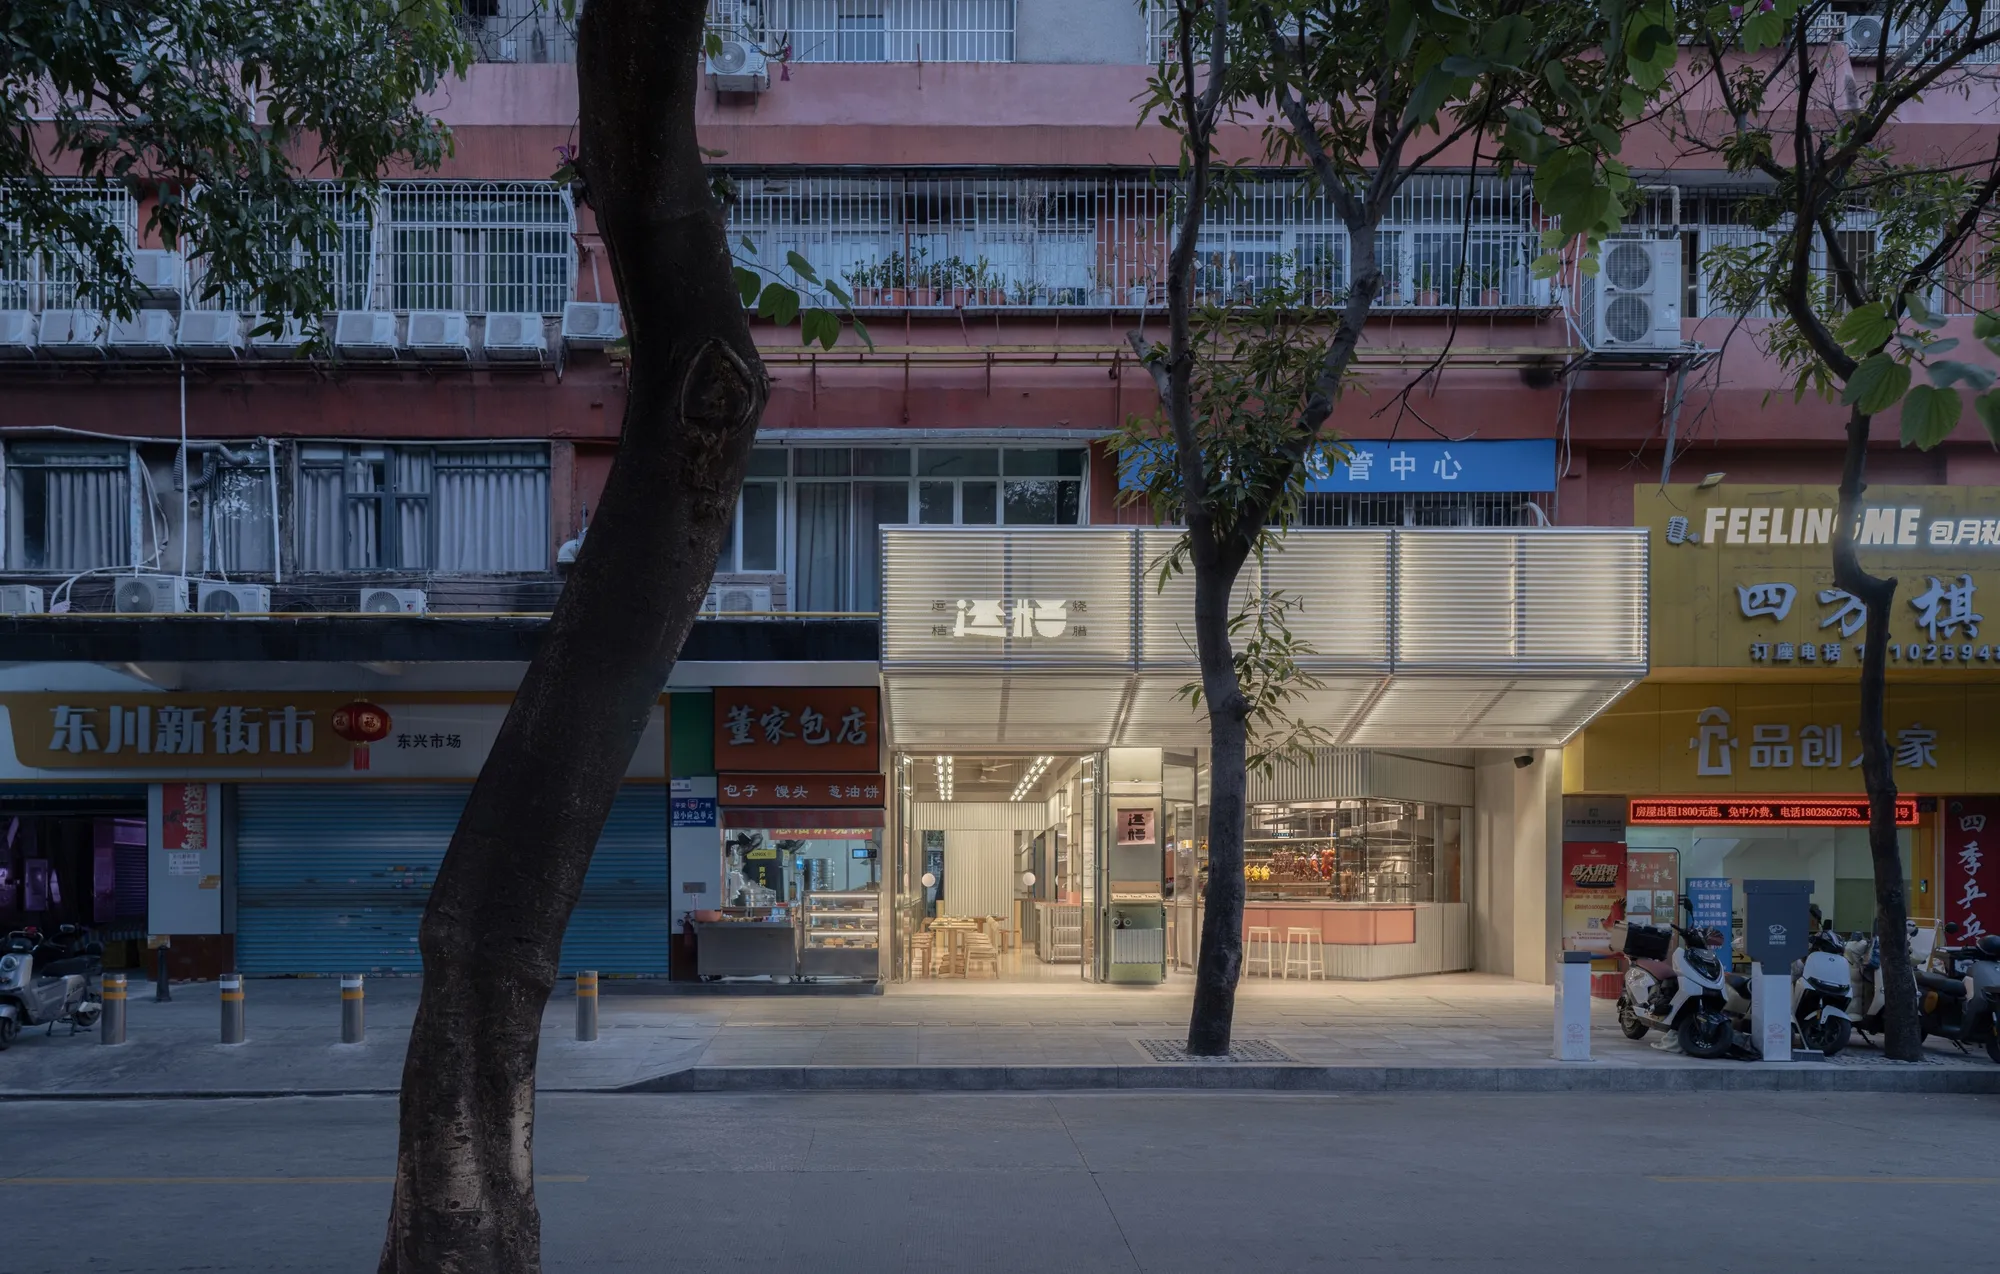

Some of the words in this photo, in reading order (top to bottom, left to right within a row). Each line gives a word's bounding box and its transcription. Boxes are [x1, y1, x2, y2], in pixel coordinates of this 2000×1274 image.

[1750, 642, 1841, 662] 订座电话
[48, 705, 315, 755] 东川新街市
[397, 733, 462, 749] 东兴市场
[723, 705, 868, 746] 董家包店
[1749, 722, 1938, 769] 品创家
[723, 784, 759, 798] 包子
[774, 784, 809, 798] 馒头
[828, 784, 880, 798] 葱油饼
[1956, 814, 1987, 943] 四季乒乓
